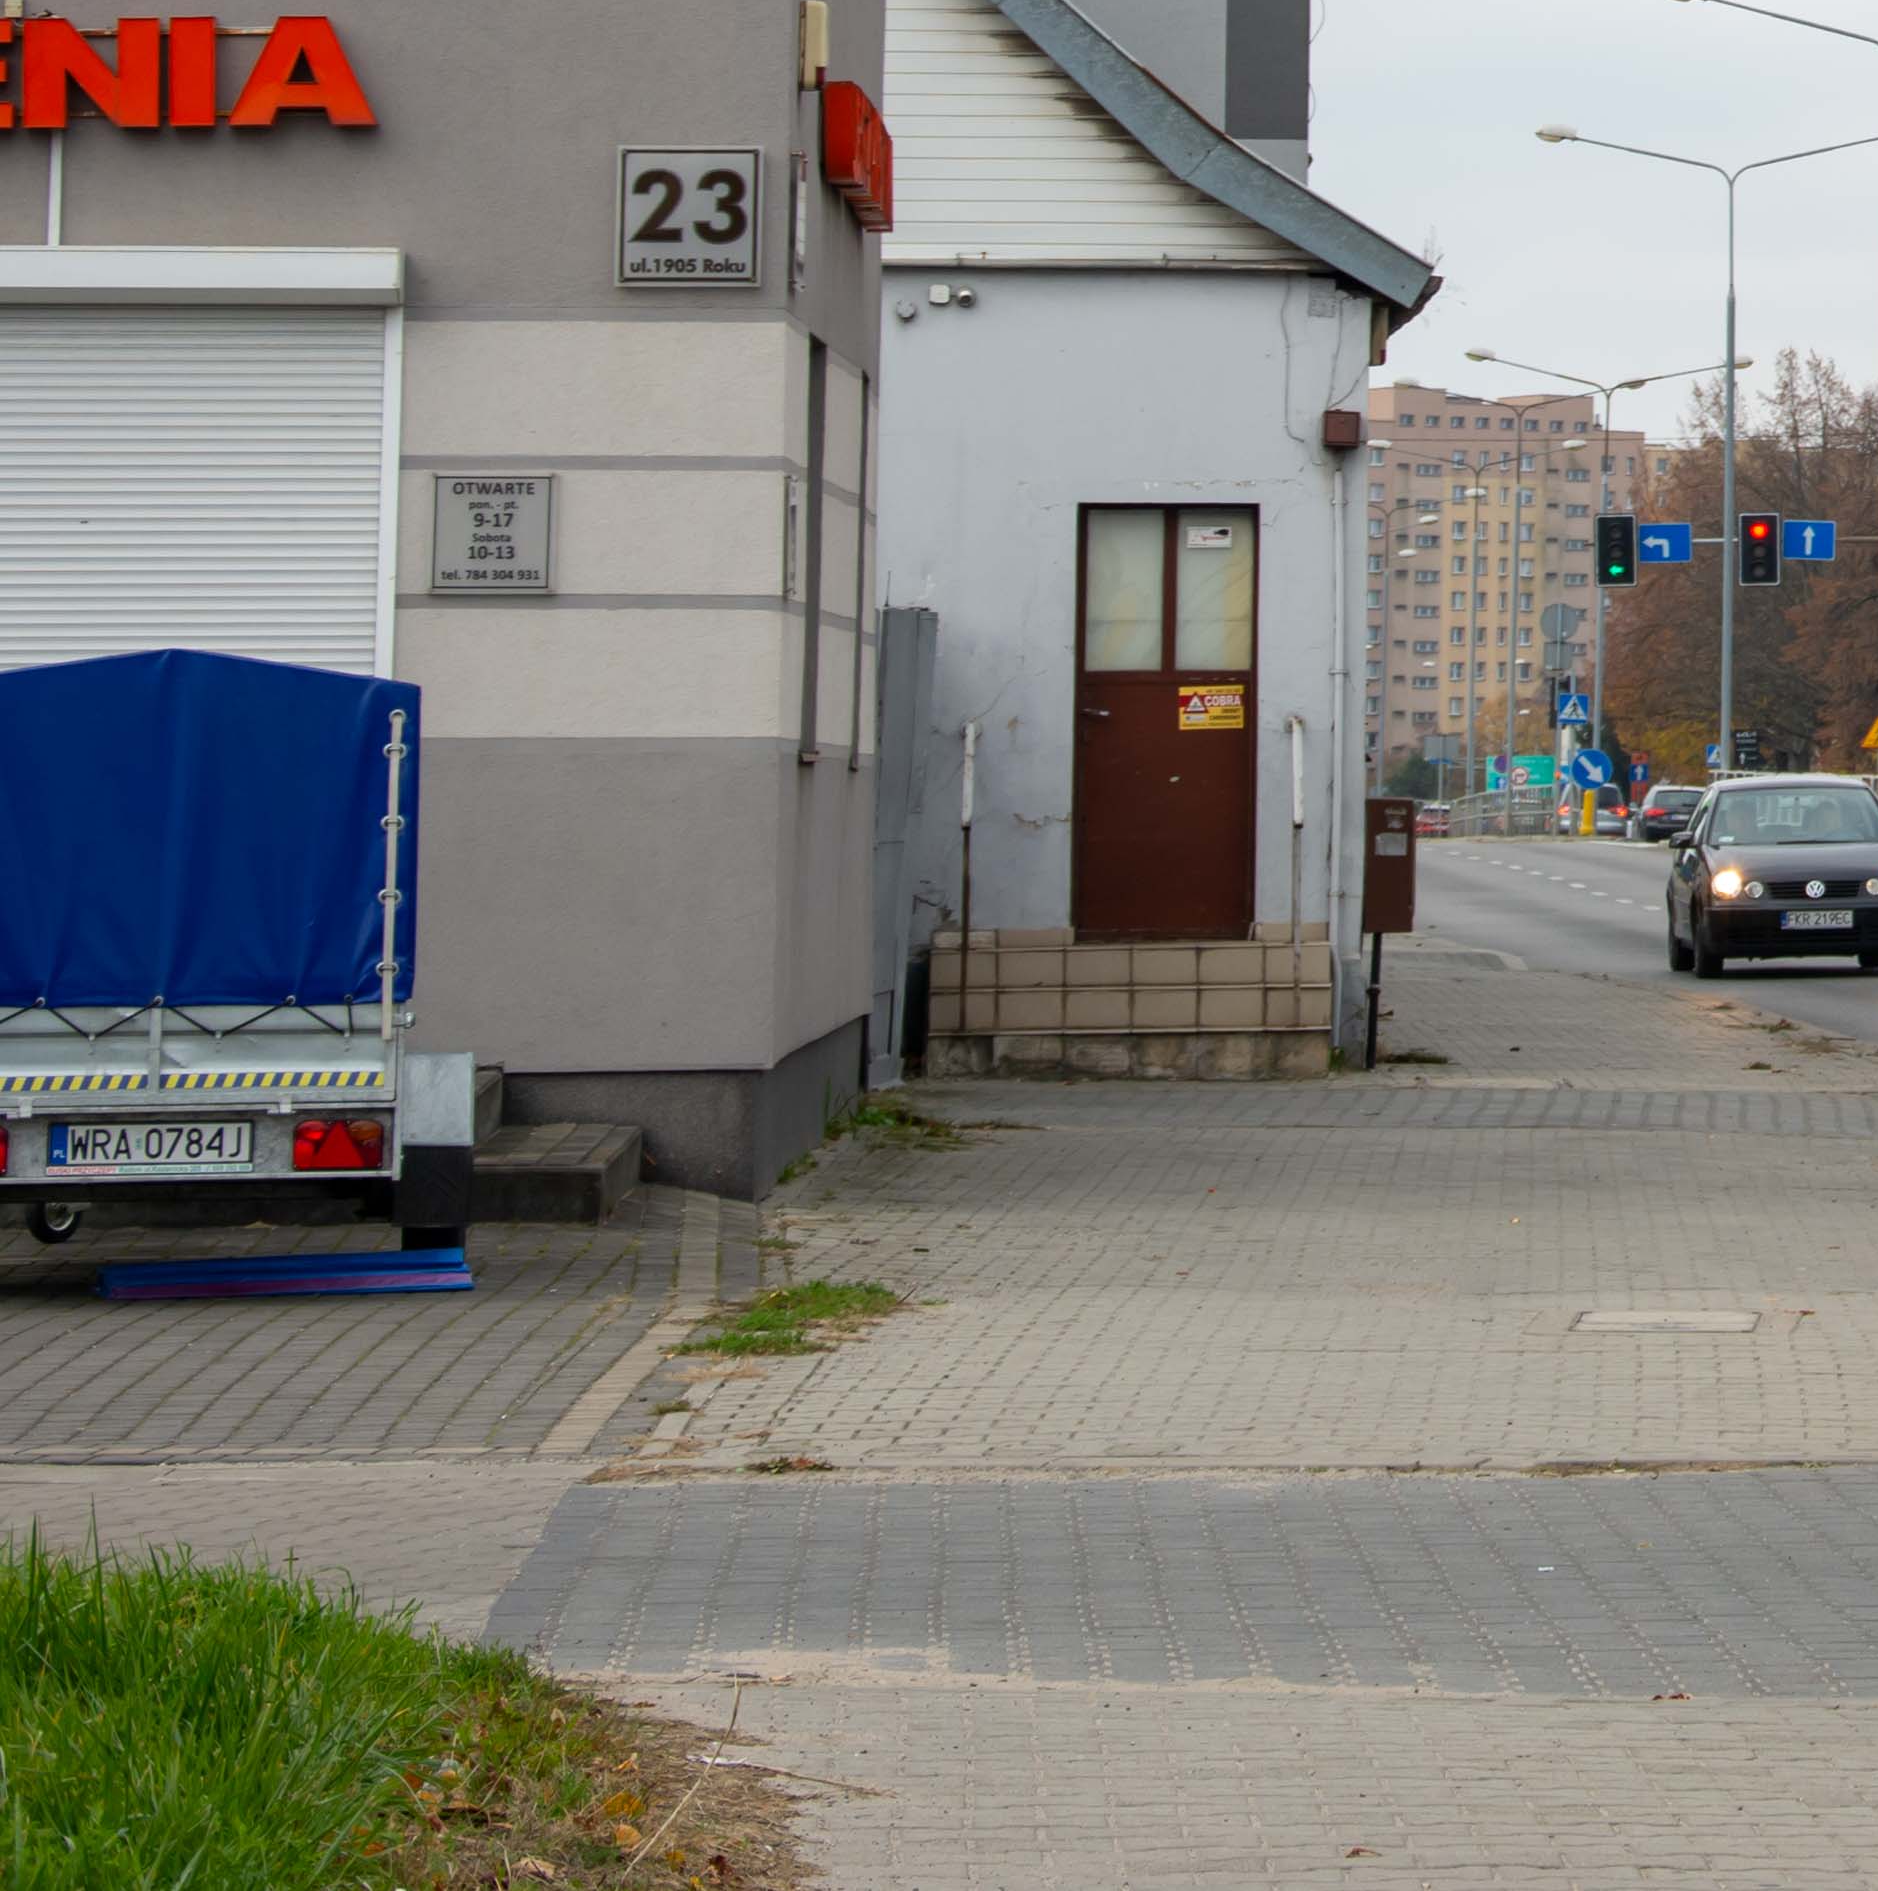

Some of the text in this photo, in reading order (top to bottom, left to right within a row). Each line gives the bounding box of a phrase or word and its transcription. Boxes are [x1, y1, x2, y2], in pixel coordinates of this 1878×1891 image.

[627, 168, 748, 245] 23
[630, 258, 746, 274] ul.1905 Roku
[453, 482, 536, 495] OTWARTE
[474, 512, 514, 528] 9-17
[472, 533, 512, 543] Sobota
[467, 545, 516, 560] 10-13
[441, 570, 540, 581] tel. 784 304 931
[1204, 695, 1241, 706] COBRA
[53, 1126, 243, 1160] PL WRA 0784J
